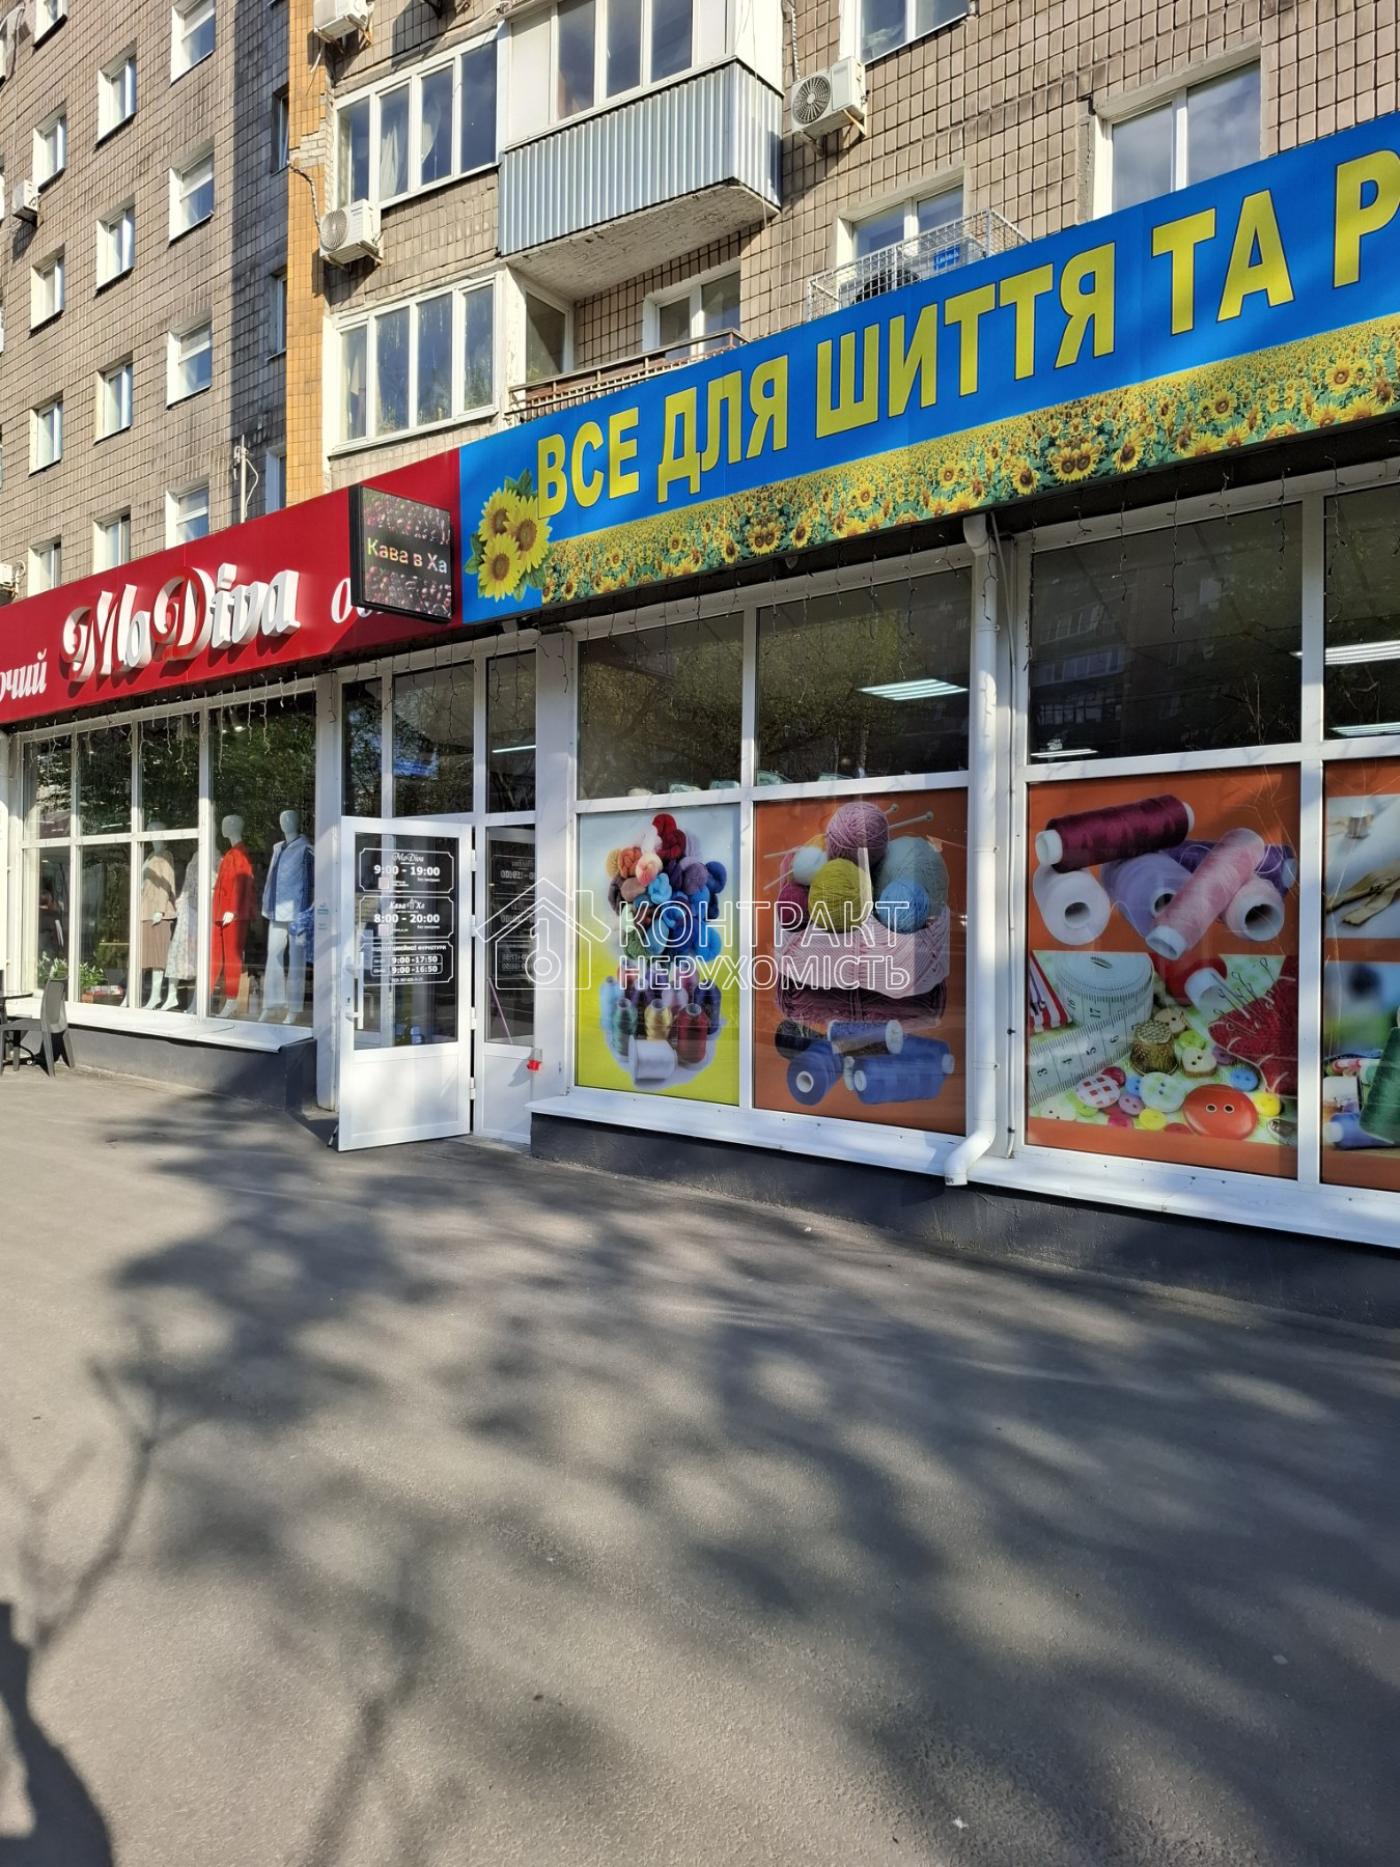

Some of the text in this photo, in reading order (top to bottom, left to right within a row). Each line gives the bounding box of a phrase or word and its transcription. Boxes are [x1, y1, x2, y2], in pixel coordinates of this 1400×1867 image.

[537, 149, 1400, 519] ВСЕ ДЛЯ ШИТТЯ ТА Р
[367, 537, 448, 575] Кава в Ха
[374, 864, 399, 876] 9:00
[410, 866, 440, 876] 19:00
[374, 913, 399, 924] 8:00
[410, 913, 440, 924] 20:00
[391, 966, 410, 974] 9:00
[1086, 1046, 1097, 1056] 5
[1036, 1067, 1048, 1078] 3
